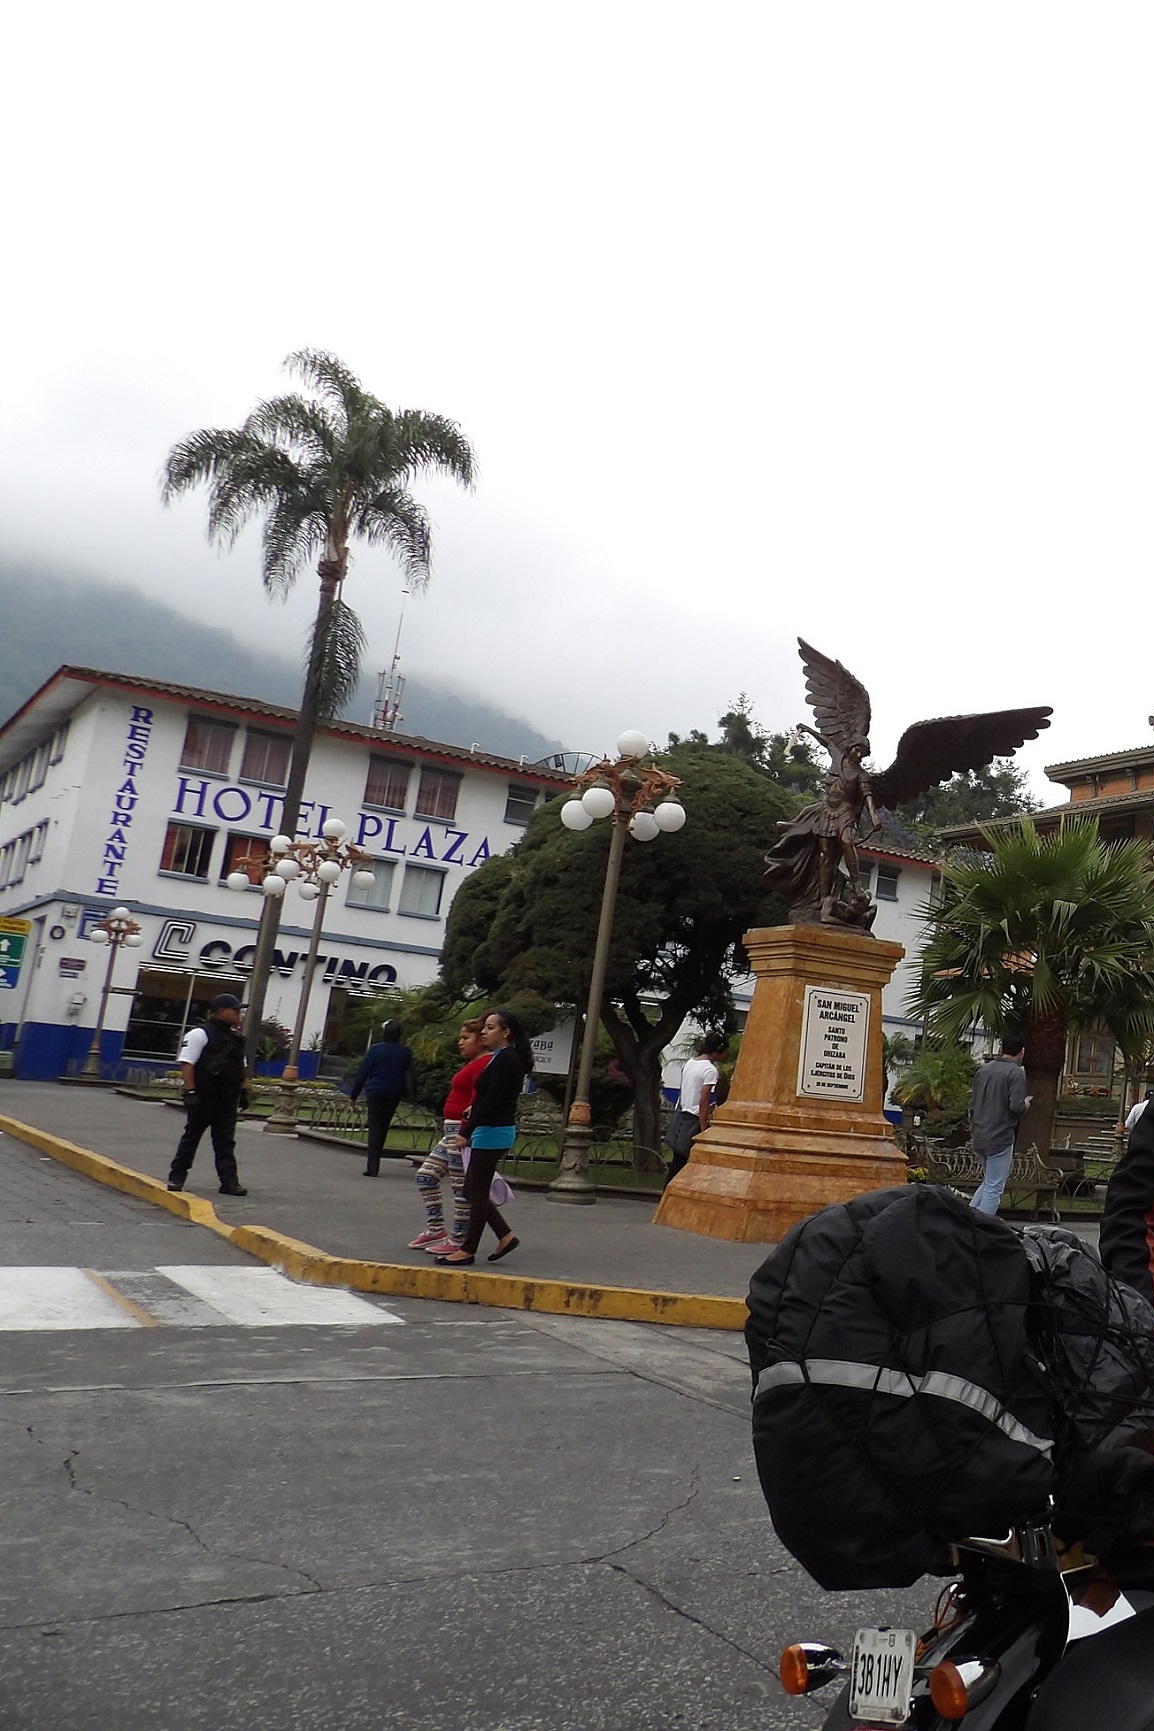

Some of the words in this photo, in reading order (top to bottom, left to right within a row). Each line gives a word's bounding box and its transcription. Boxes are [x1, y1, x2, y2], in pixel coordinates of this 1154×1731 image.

[95, 705, 154, 897] RESTAURANTE
[172, 776, 333, 839] HOTEL
[354, 812, 493, 868] PLAZA
[817, 1000, 832, 1009] SAN
[833, 1001, 859, 1013] MIGUEL
[819, 1011, 856, 1023] ARCÁNGEL
[828, 1026, 845, 1035] SANTO
[824, 1034, 848, 1043] PATRONO
[823, 1050, 846, 1059] ORIZABA
[858, 1653, 903, 1697] 381HY
